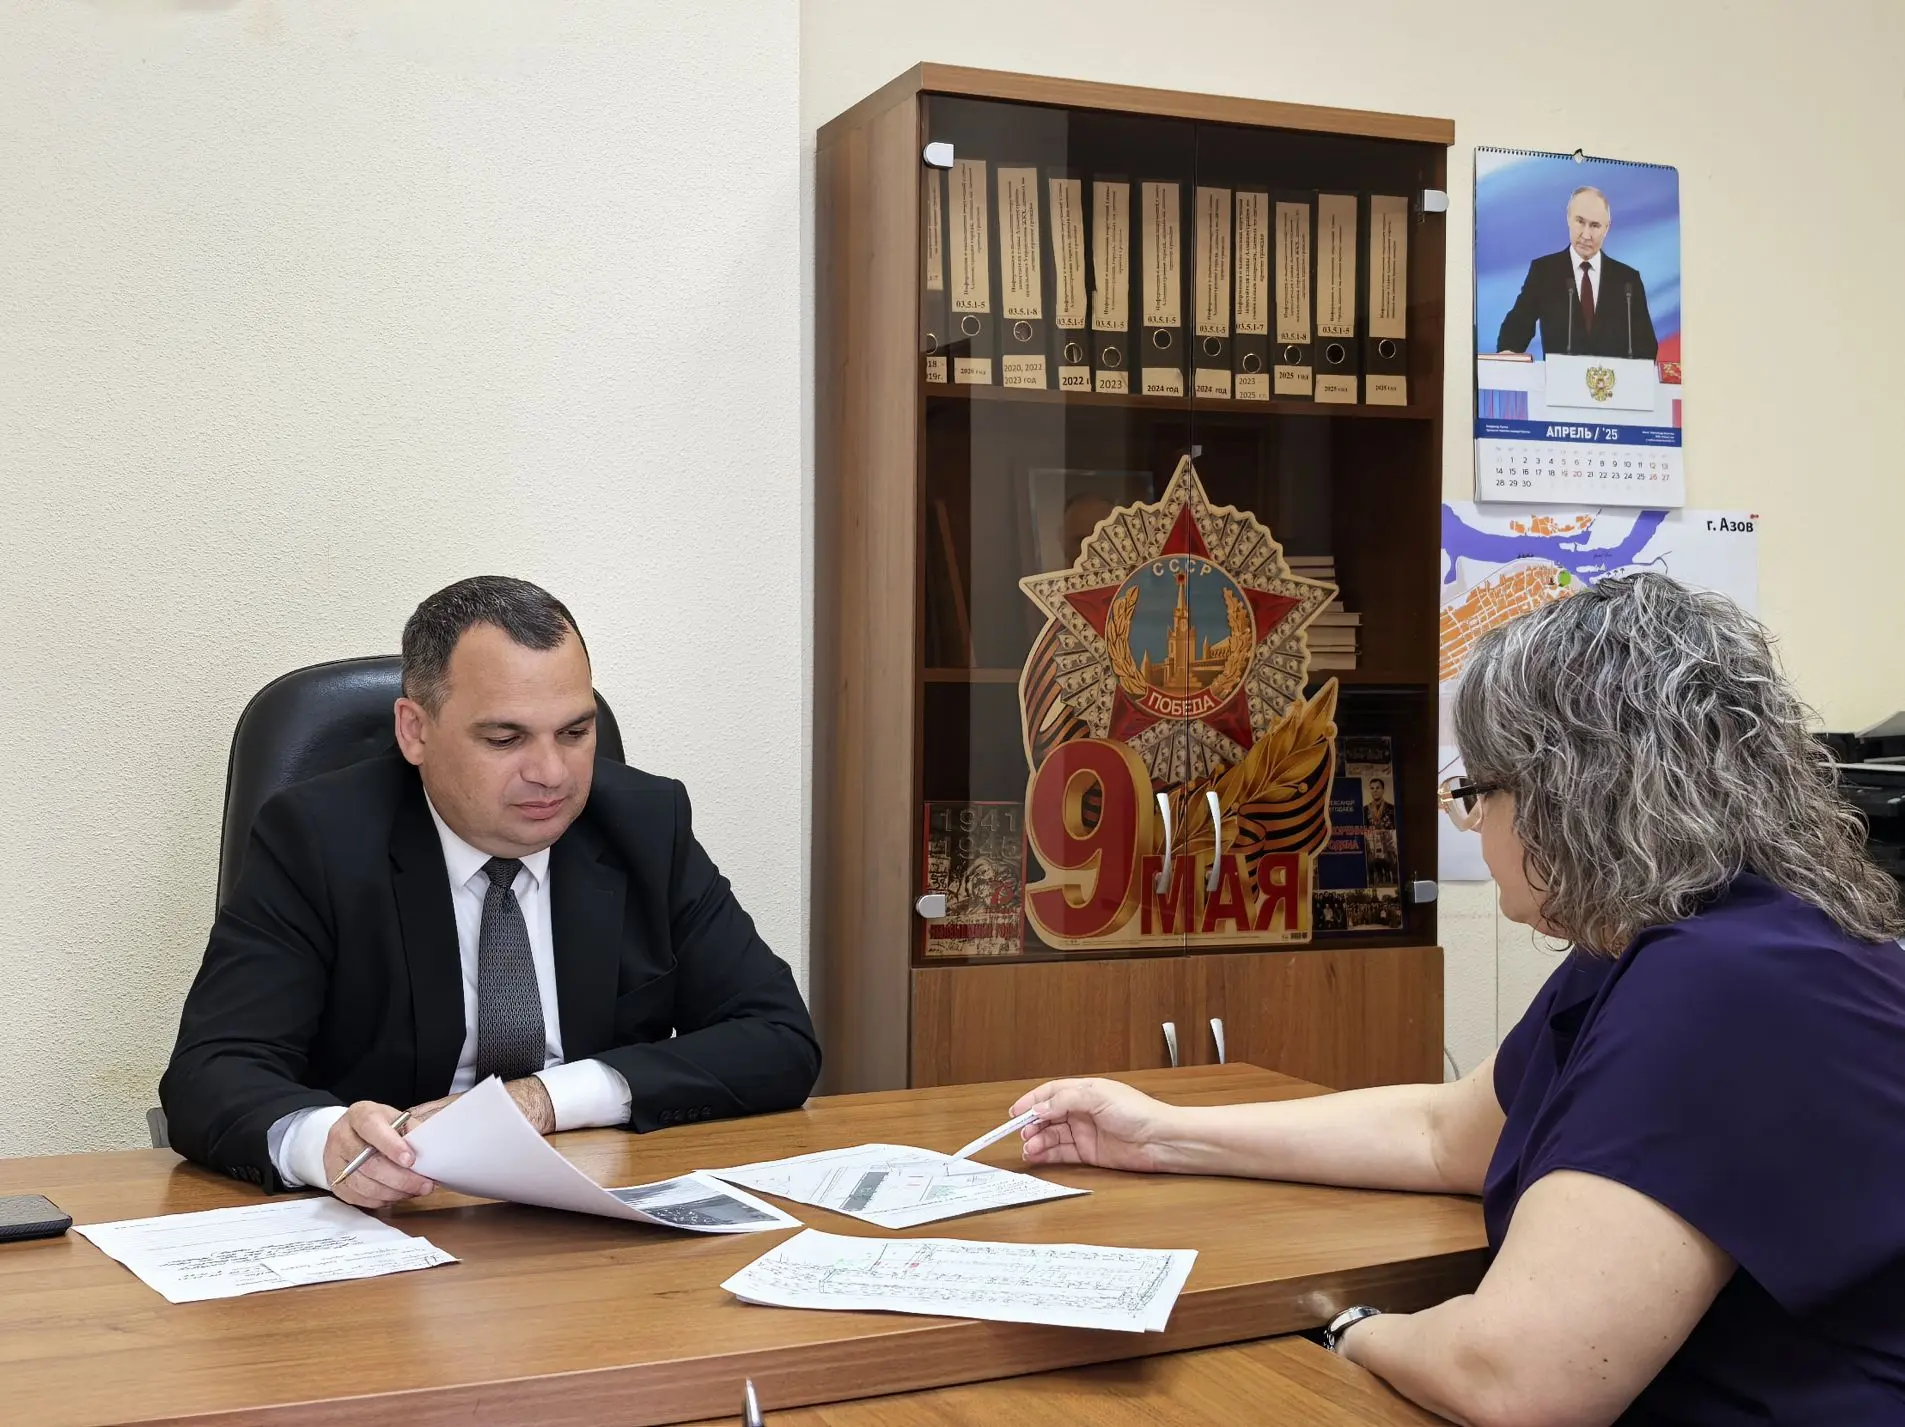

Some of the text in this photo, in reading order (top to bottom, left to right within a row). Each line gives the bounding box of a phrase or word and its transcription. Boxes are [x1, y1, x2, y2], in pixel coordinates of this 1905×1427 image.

[1147, 316, 1176, 324] 03.5.1-5
[1062, 377, 1084, 386] 2022
[1100, 380, 1122, 389] 2023
[1546, 426, 1592, 440] АПРЕЛЬ
[1706, 518, 1754, 533] г. Азов
[1152, 559, 1212, 577] СССР
[1148, 692, 1214, 716] ПОБЕДА
[940, 808, 1018, 832] 1941
[1026, 739, 1308, 940] 9 МАЯ
